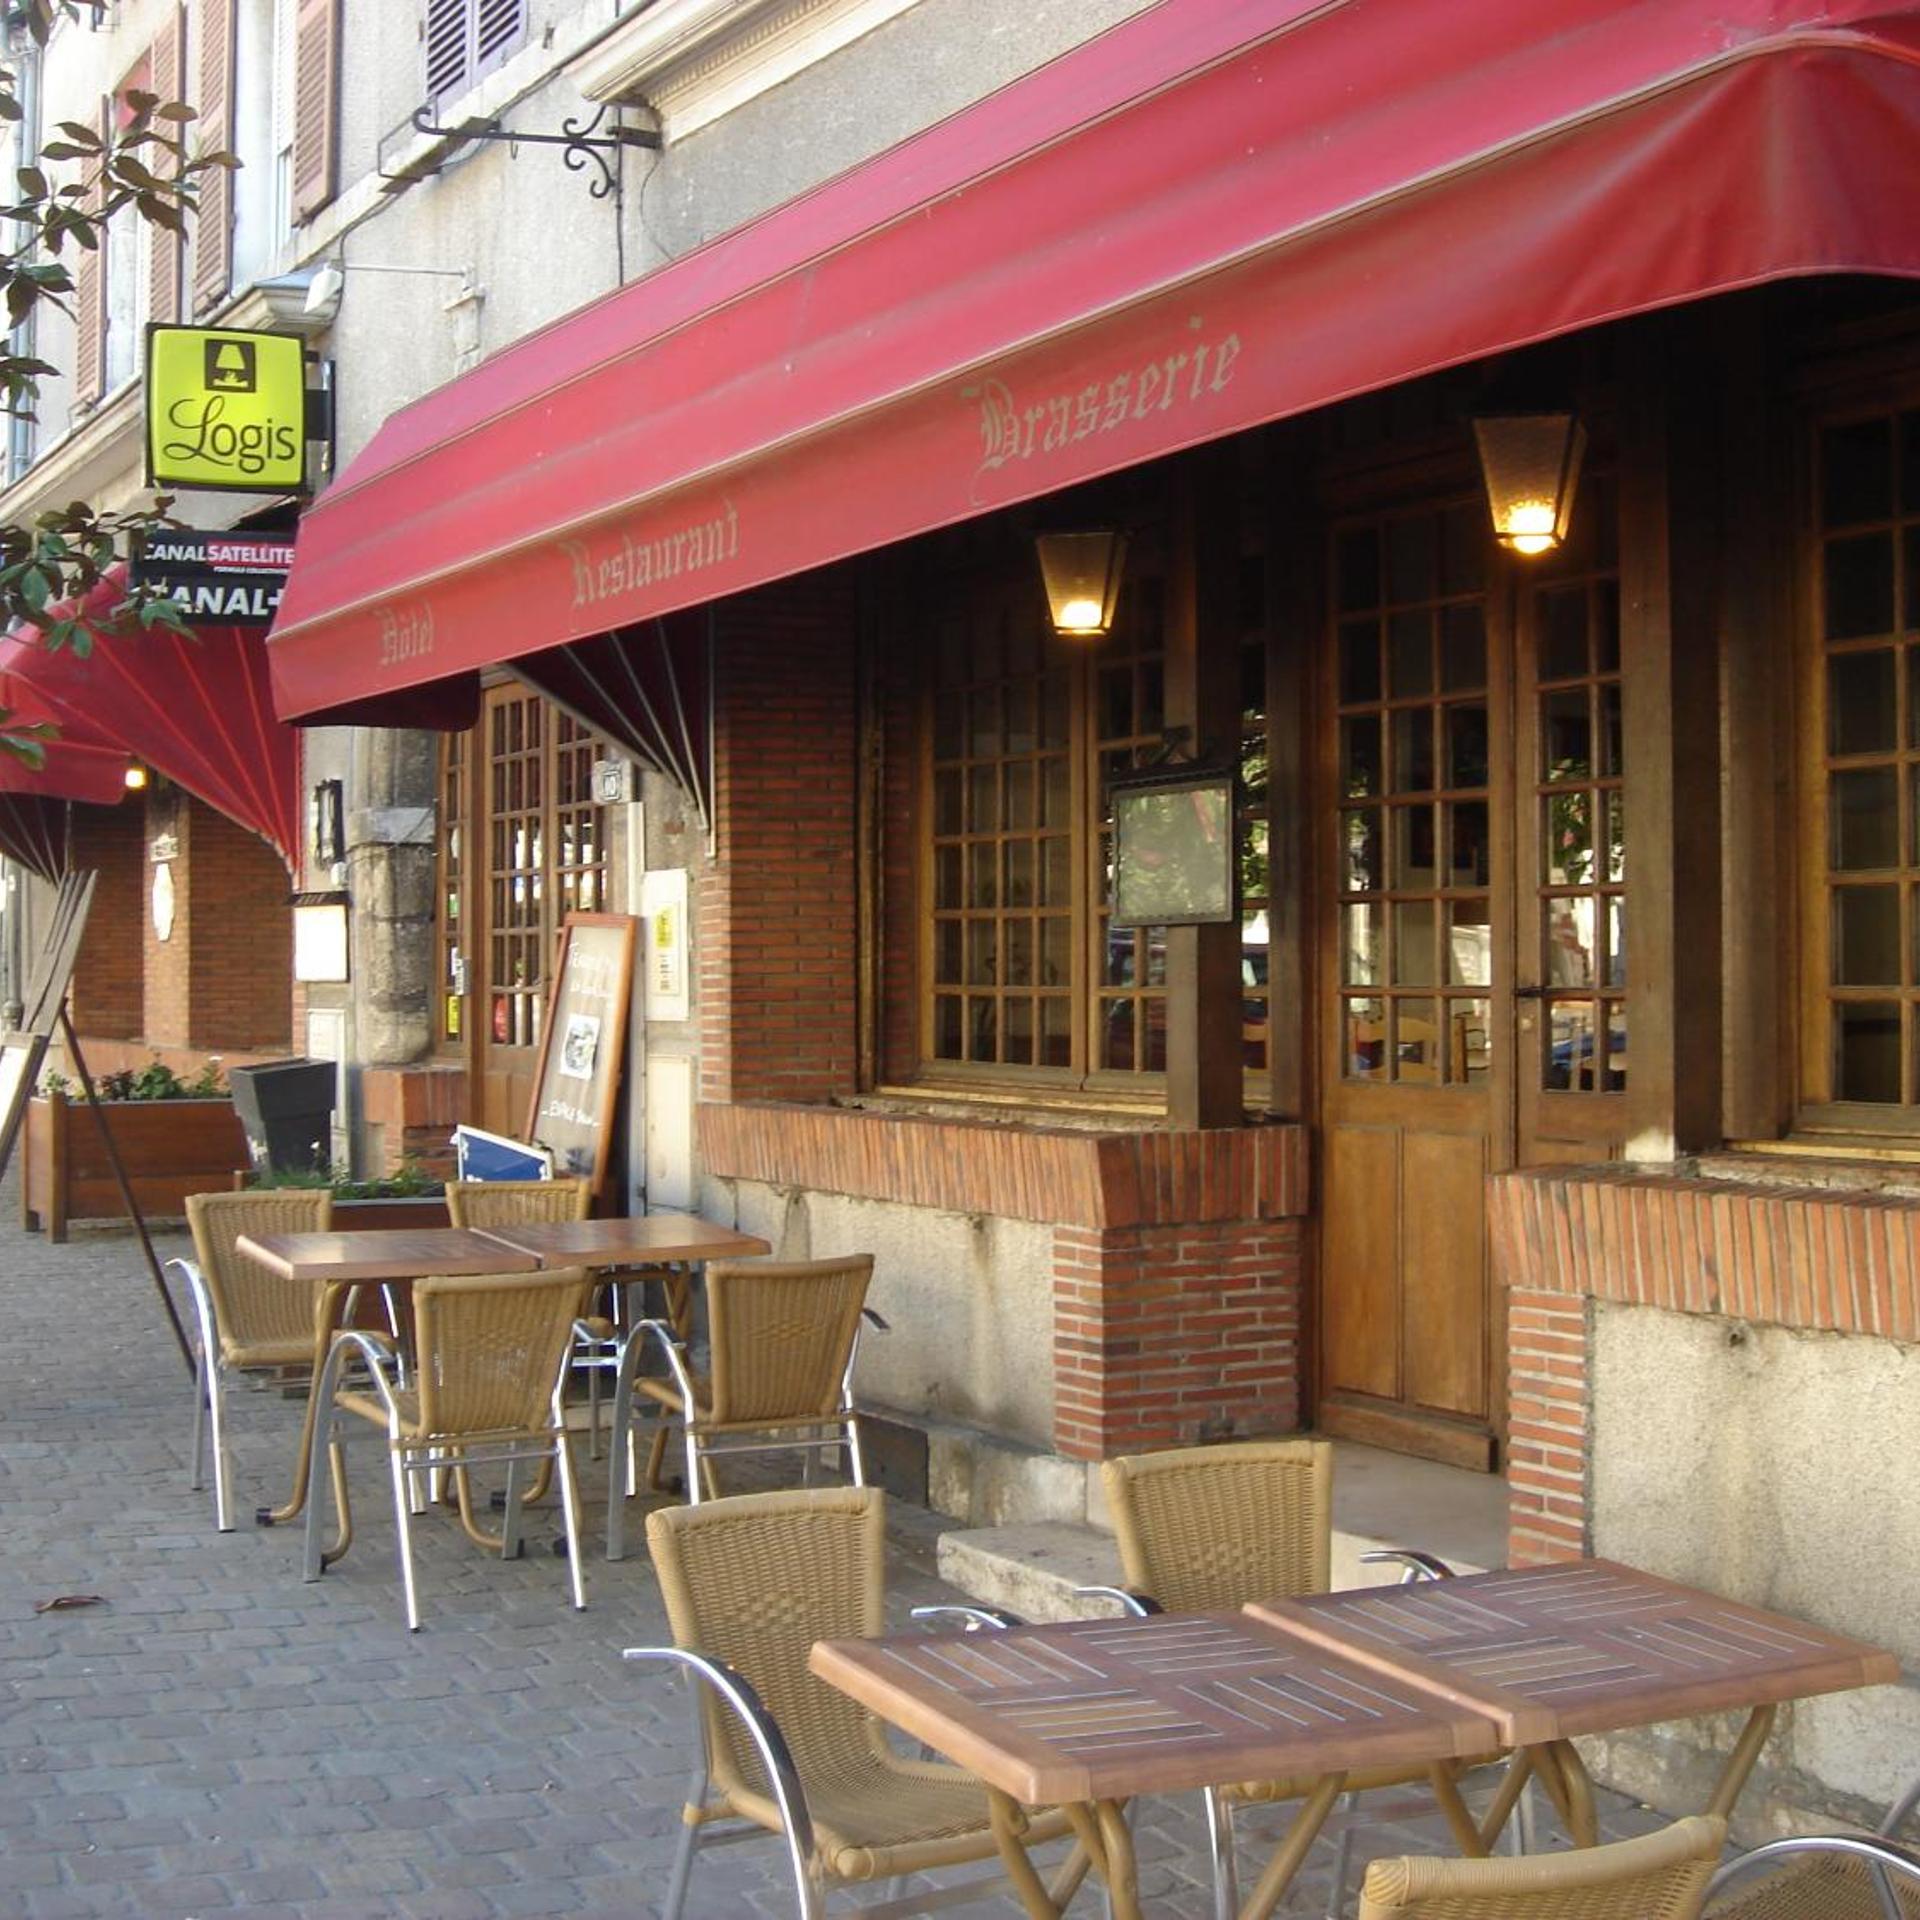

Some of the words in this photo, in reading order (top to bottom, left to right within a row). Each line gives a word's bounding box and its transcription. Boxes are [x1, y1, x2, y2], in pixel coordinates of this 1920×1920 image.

[163, 395, 296, 474] Logis
[962, 314, 1241, 505] Brasserie
[151, 585, 285, 616] ANAL
[559, 497, 739, 630] Restaurant
